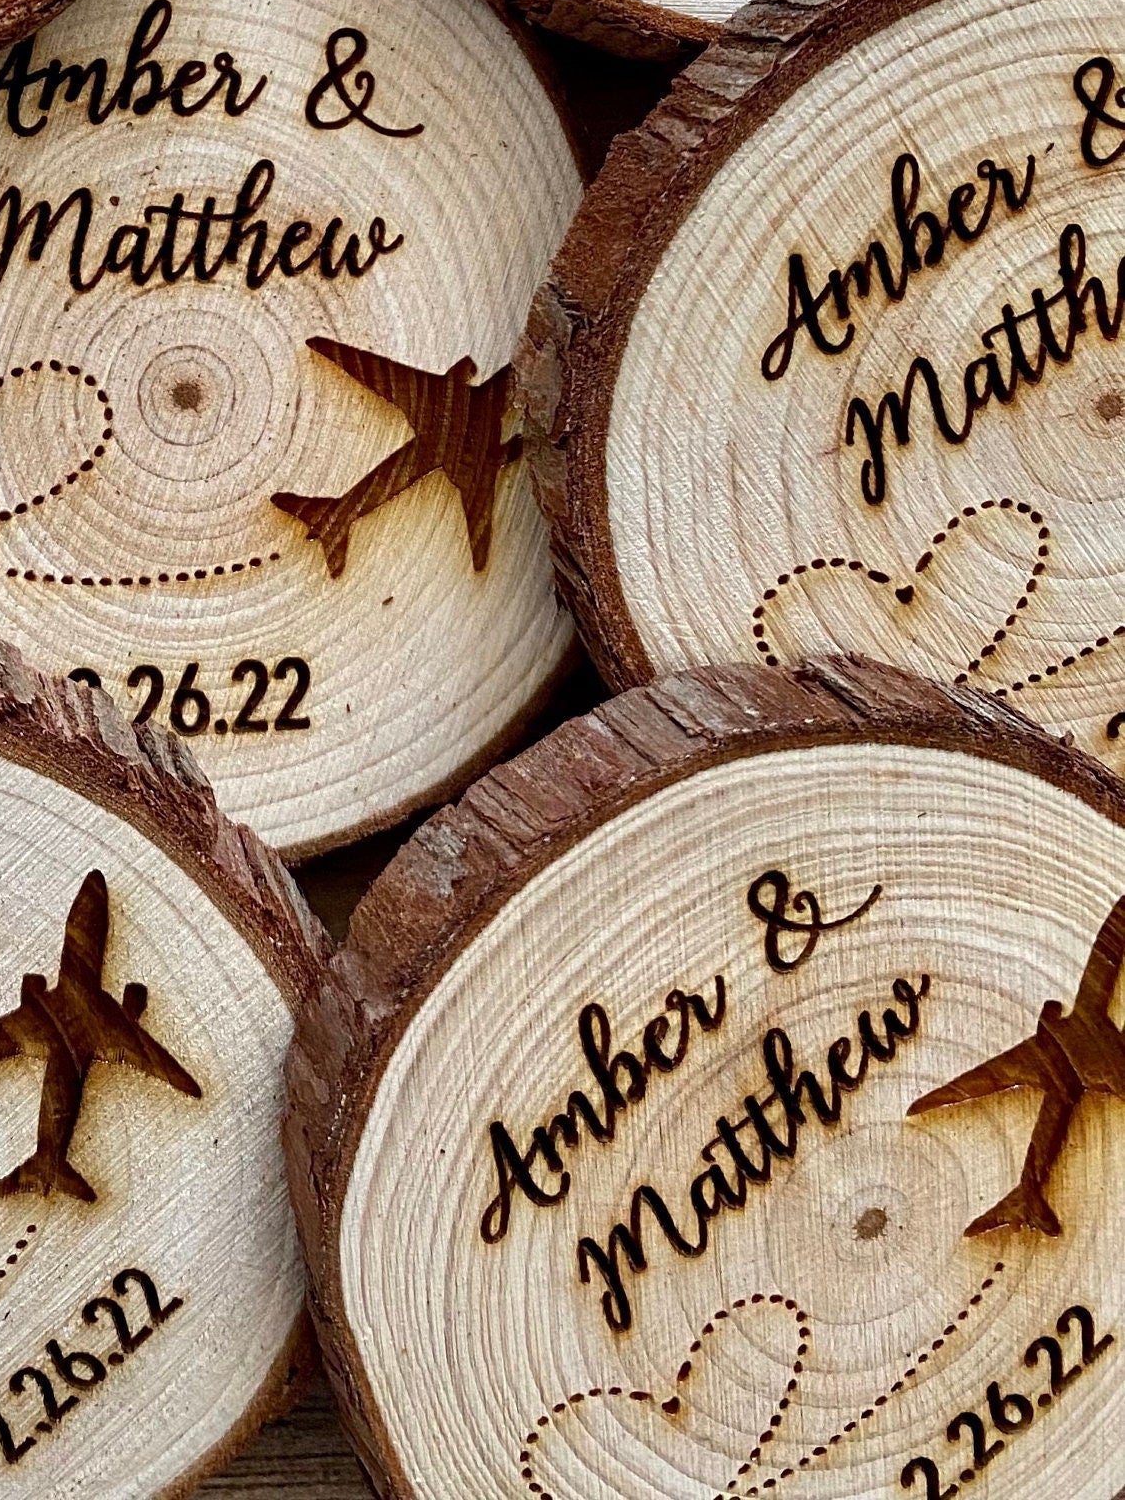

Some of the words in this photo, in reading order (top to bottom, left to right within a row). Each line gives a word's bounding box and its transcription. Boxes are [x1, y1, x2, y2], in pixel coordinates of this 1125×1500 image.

[305, 27, 425, 138] &
[761, 153, 1035, 381] Amber
[845, 223, 1125, 506] Matth
[480, 975, 725, 1245] Amber
[747, 870, 883, 972] &
[577, 973, 931, 1333] Matthew
[900, 1305, 1115, 1500] 2.26.22
